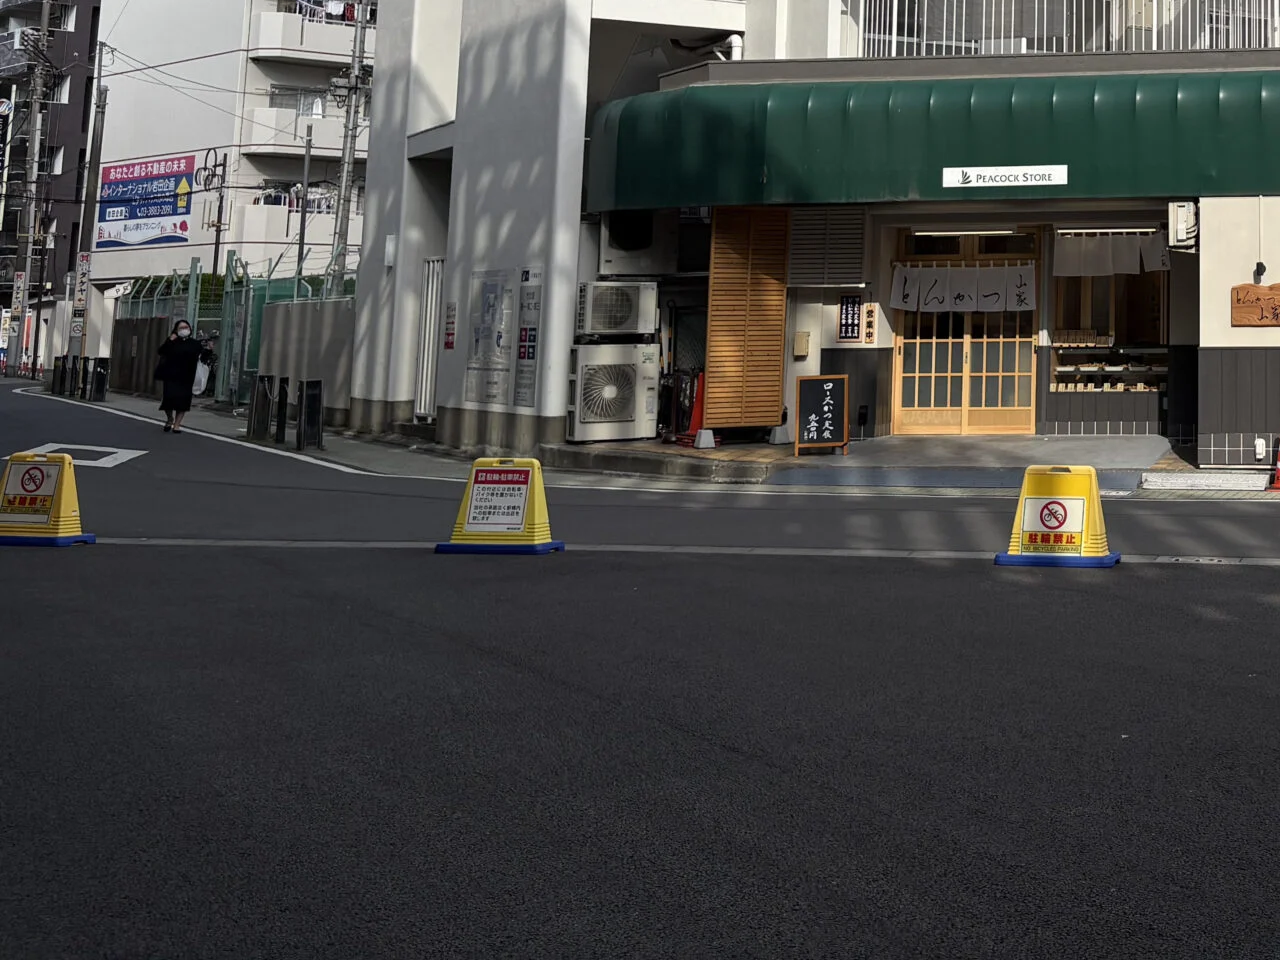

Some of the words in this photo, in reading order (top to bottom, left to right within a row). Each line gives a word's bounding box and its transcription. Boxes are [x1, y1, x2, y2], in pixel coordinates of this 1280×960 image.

[976, 173, 1020, 183] PEACOCK
[1022, 172, 1053, 182] STORE
[865, 309, 875, 340] 営業中
[1028, 533, 1076, 545] 駐輪禁止
